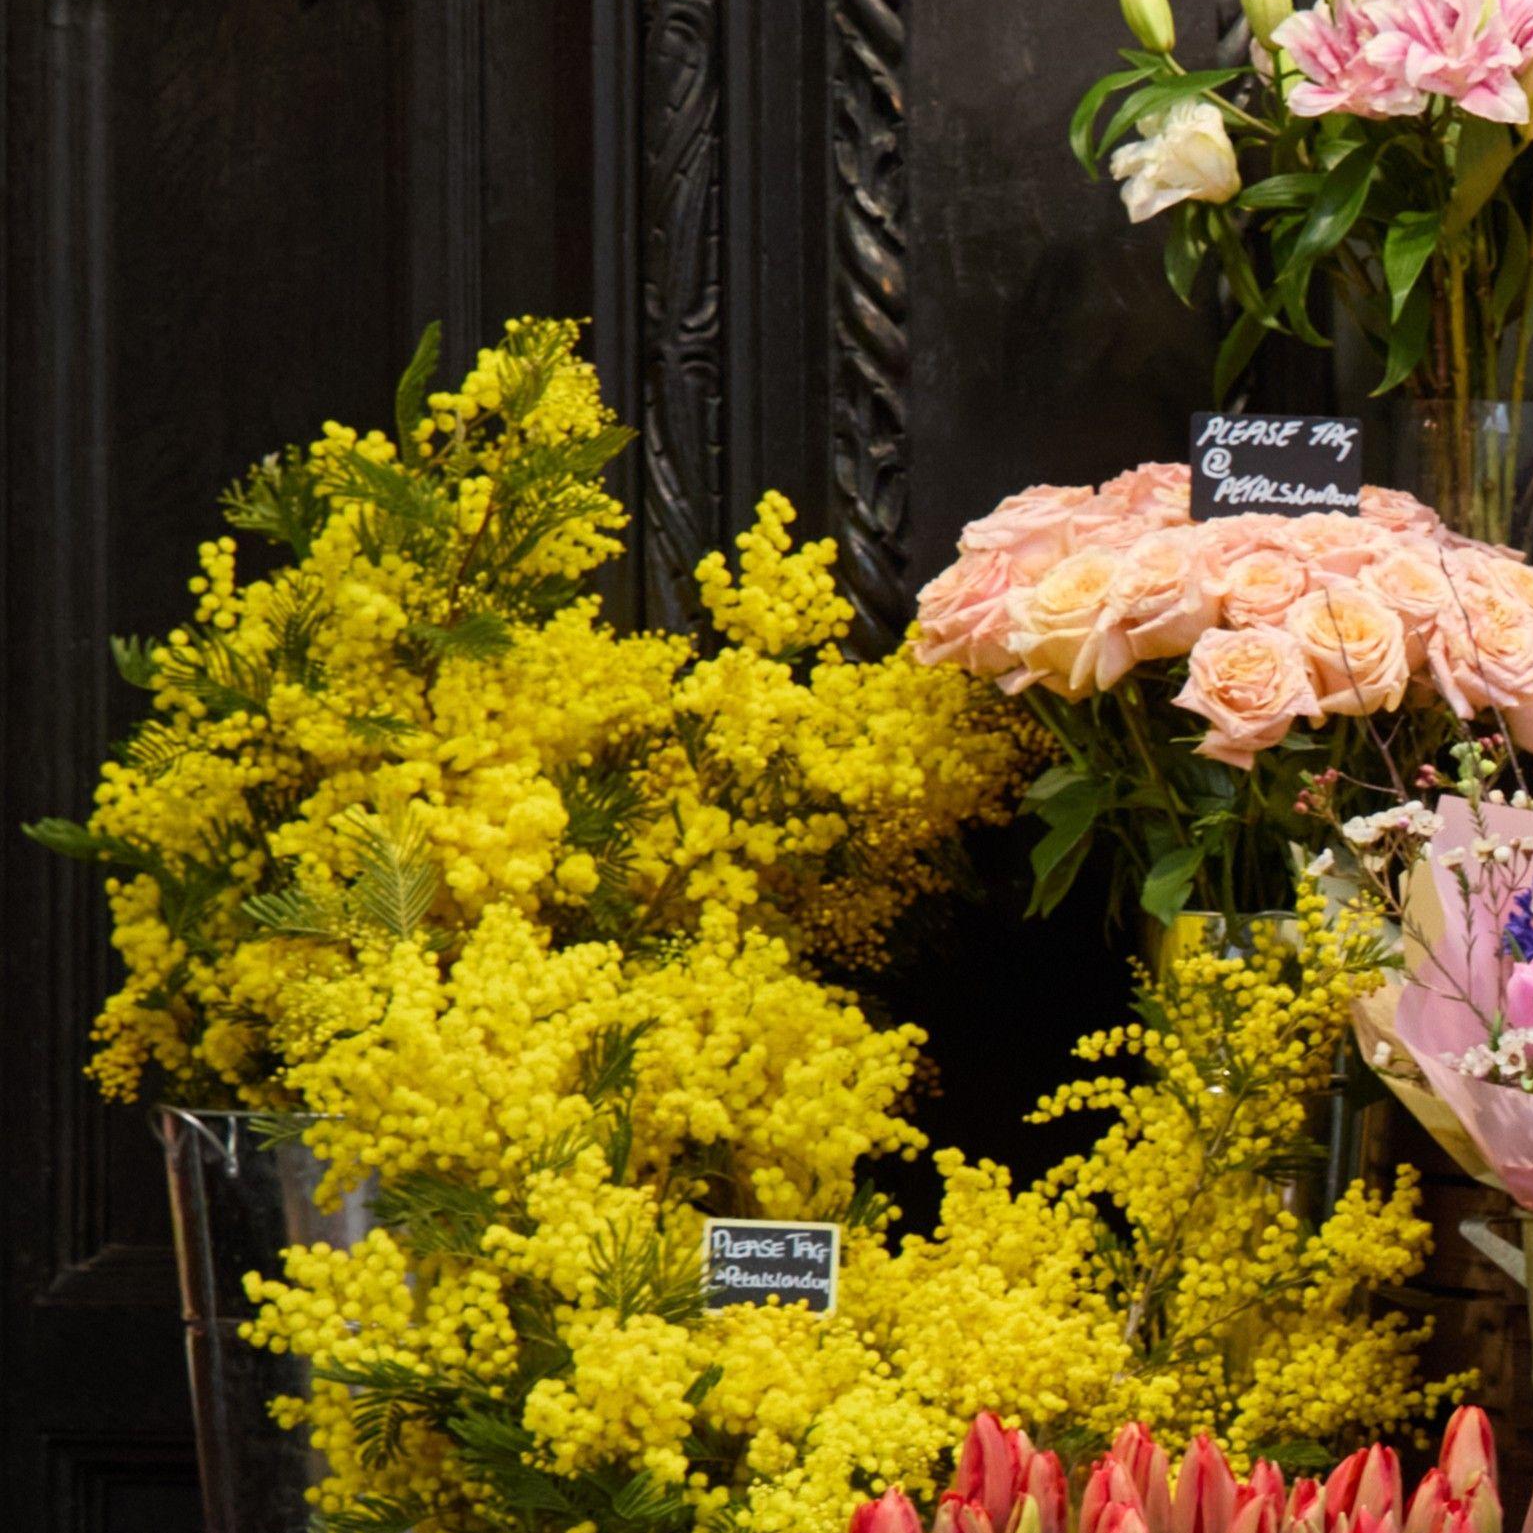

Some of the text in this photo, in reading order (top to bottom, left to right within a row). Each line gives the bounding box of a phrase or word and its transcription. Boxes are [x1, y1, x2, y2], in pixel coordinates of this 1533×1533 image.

[1196, 416, 1359, 462] PLEASE TAG
[1201, 446, 1232, 480] @
